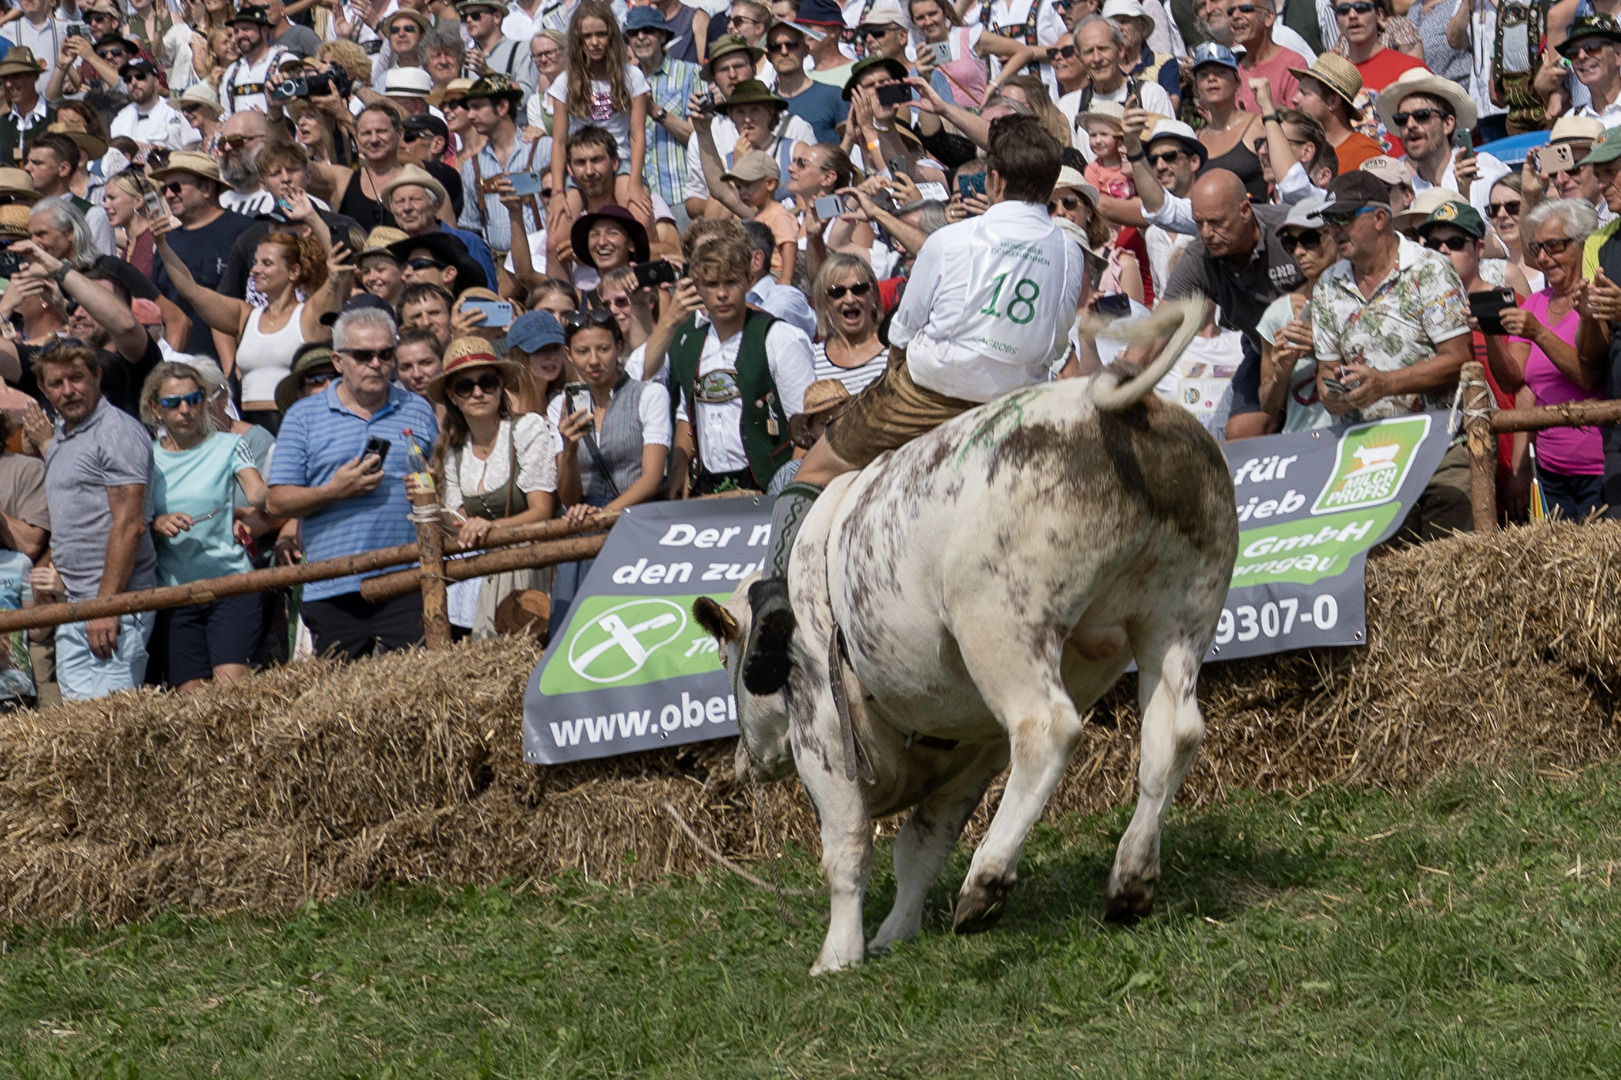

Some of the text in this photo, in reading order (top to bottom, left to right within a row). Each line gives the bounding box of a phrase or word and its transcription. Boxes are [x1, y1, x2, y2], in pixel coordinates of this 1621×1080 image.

[980, 272, 1040, 325] 18
[1233, 454, 1298, 486] für
[1325, 481, 1392, 506] PROFIS
[658, 523, 741, 548] Der
[1242, 518, 1375, 558] GmbH
[611, 558, 693, 584] den
[1215, 593, 1339, 645] 9307-0
